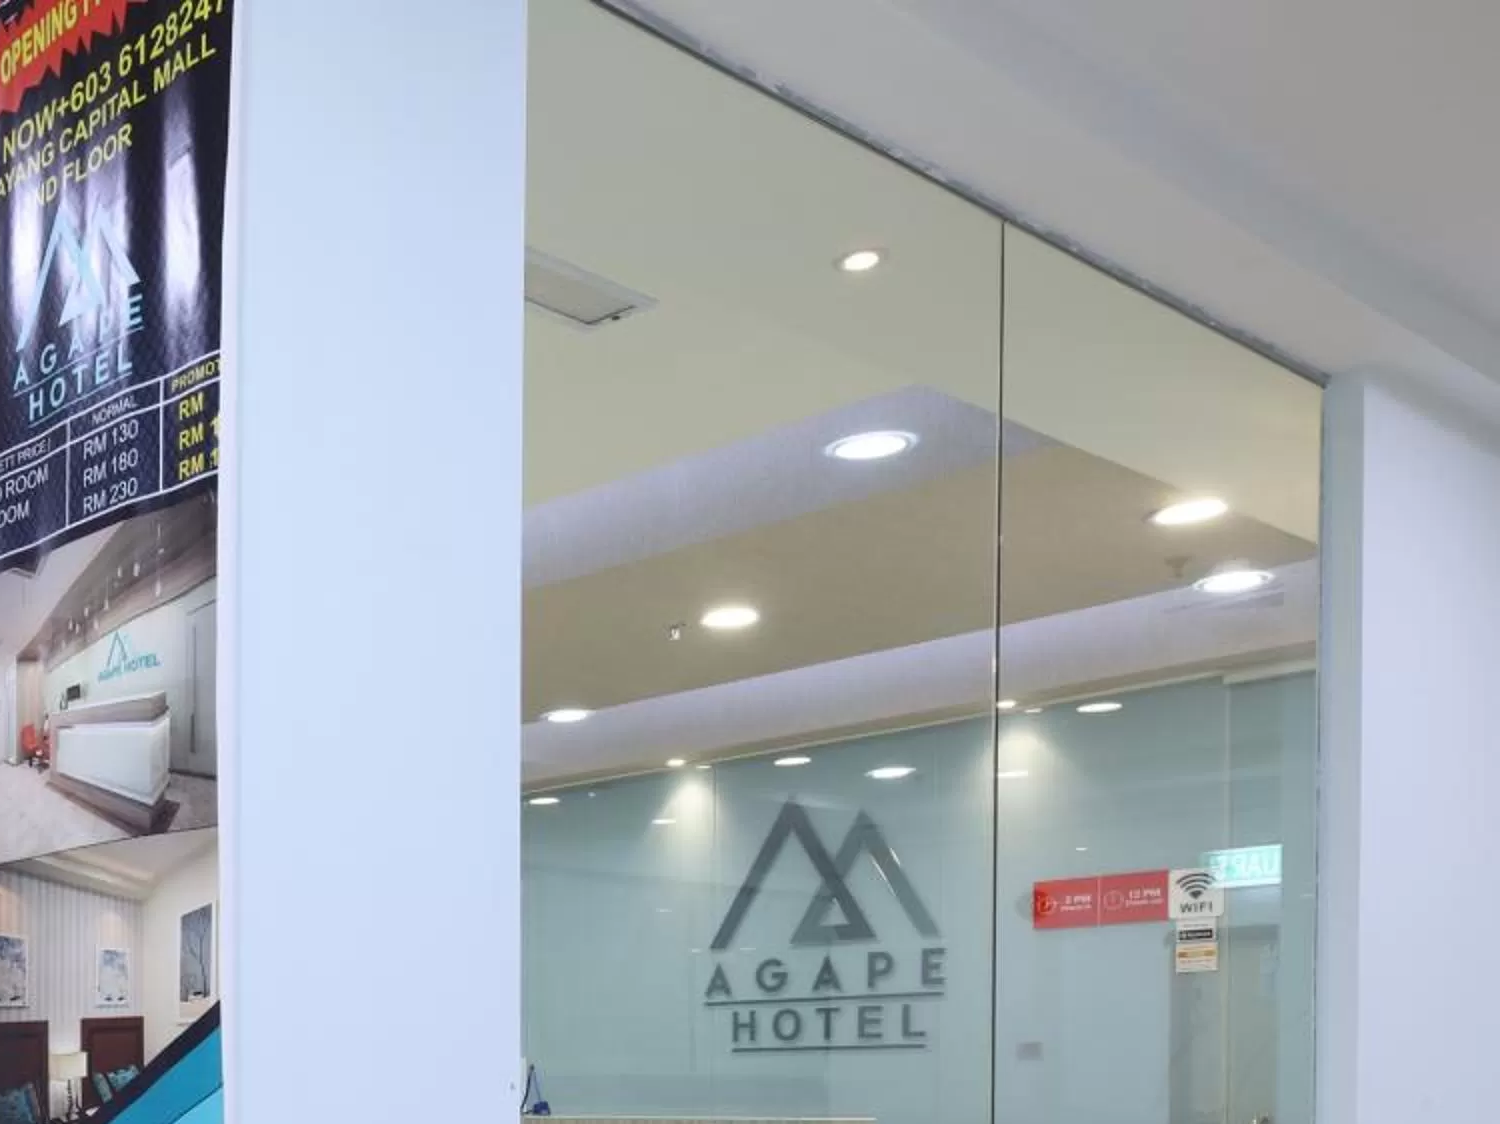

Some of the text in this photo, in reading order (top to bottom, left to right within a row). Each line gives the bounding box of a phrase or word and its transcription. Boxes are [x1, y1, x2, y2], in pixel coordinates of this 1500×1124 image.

[0, 0, 78, 84] OPENING
[59, 80, 147, 153] CAPITAL
[153, 33, 217, 93] MALL
[63, 123, 133, 189] FLOOR
[13, 293, 143, 391] AGAPE
[29, 341, 133, 422] HOTEL
[92, 396, 139, 424] NORMAL
[179, 392, 204, 420] RM
[83, 419, 139, 461] RM 130
[179, 422, 204, 450] RM
[5, 463, 49, 499] ROOM
[83, 447, 139, 488] RM 180
[179, 453, 204, 481] RM
[83, 477, 139, 515] RM 230
[1180, 901, 1213, 914] WIFI
[704, 946, 948, 998] AGAPE
[731, 1003, 927, 1043] HOTEL
